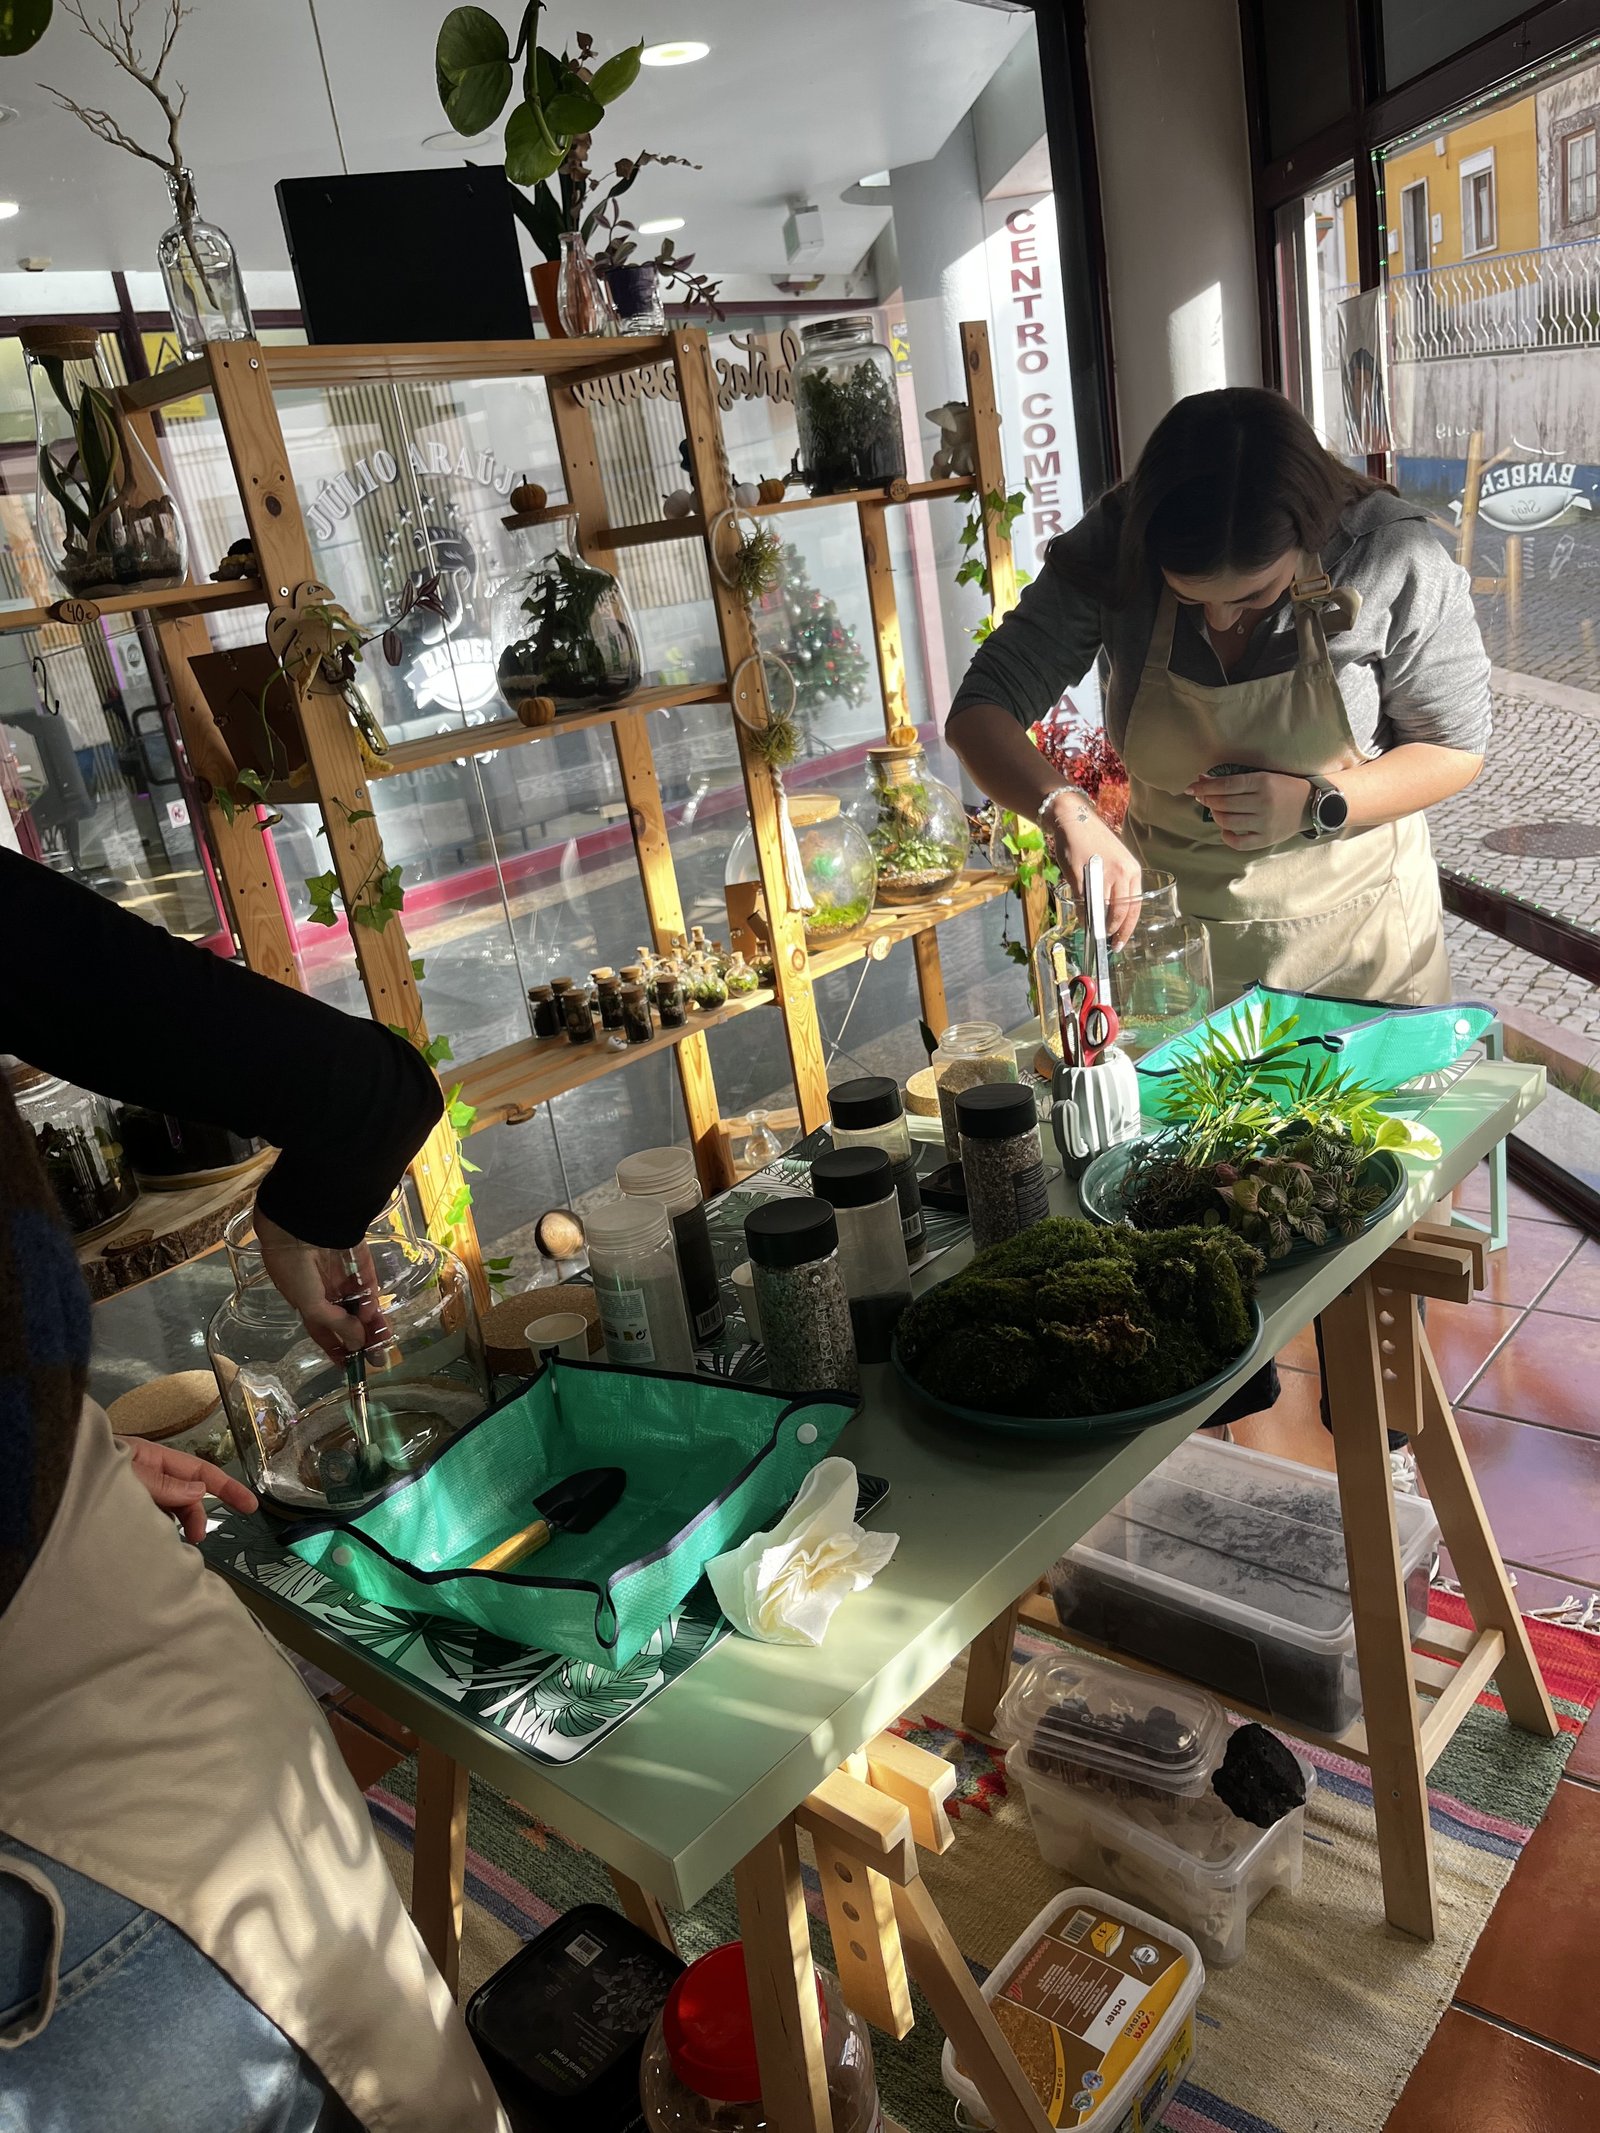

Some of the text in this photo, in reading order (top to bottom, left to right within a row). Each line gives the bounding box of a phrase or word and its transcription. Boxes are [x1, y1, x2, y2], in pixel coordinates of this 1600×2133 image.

[1005, 208, 1067, 562] CENTRO COMER
[304, 441, 518, 541] JÚLIO ARAÚJ
[1104, 1998, 1127, 2026] Ocher
